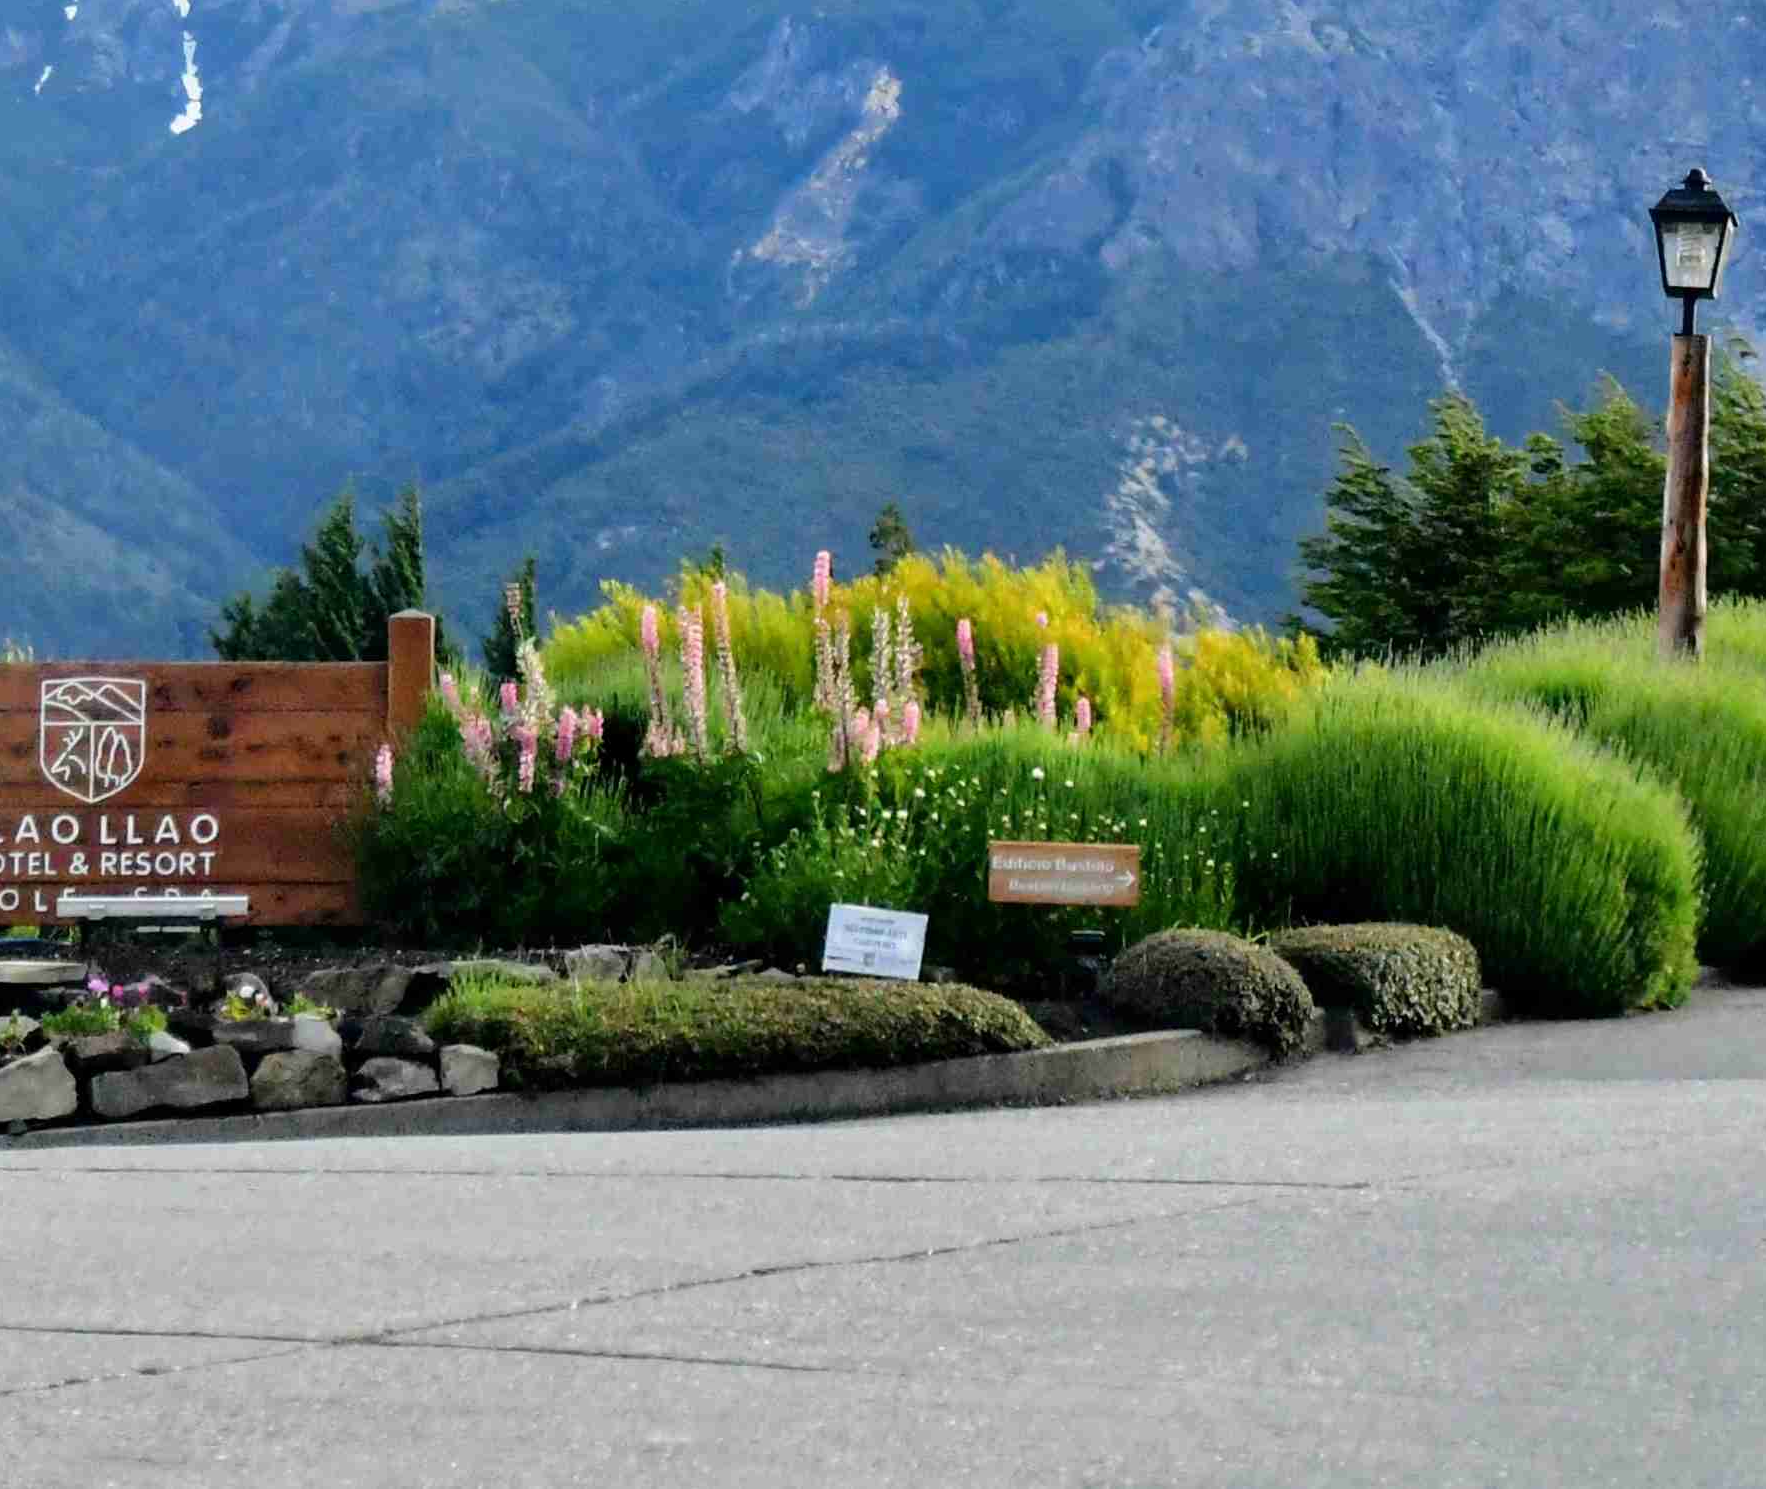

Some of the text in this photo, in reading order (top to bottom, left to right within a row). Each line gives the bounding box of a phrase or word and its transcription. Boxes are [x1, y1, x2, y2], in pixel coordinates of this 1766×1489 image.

[99, 814, 219, 844] LLAO
[68, 852, 90, 876] &
[100, 852, 216, 876] RESORT
